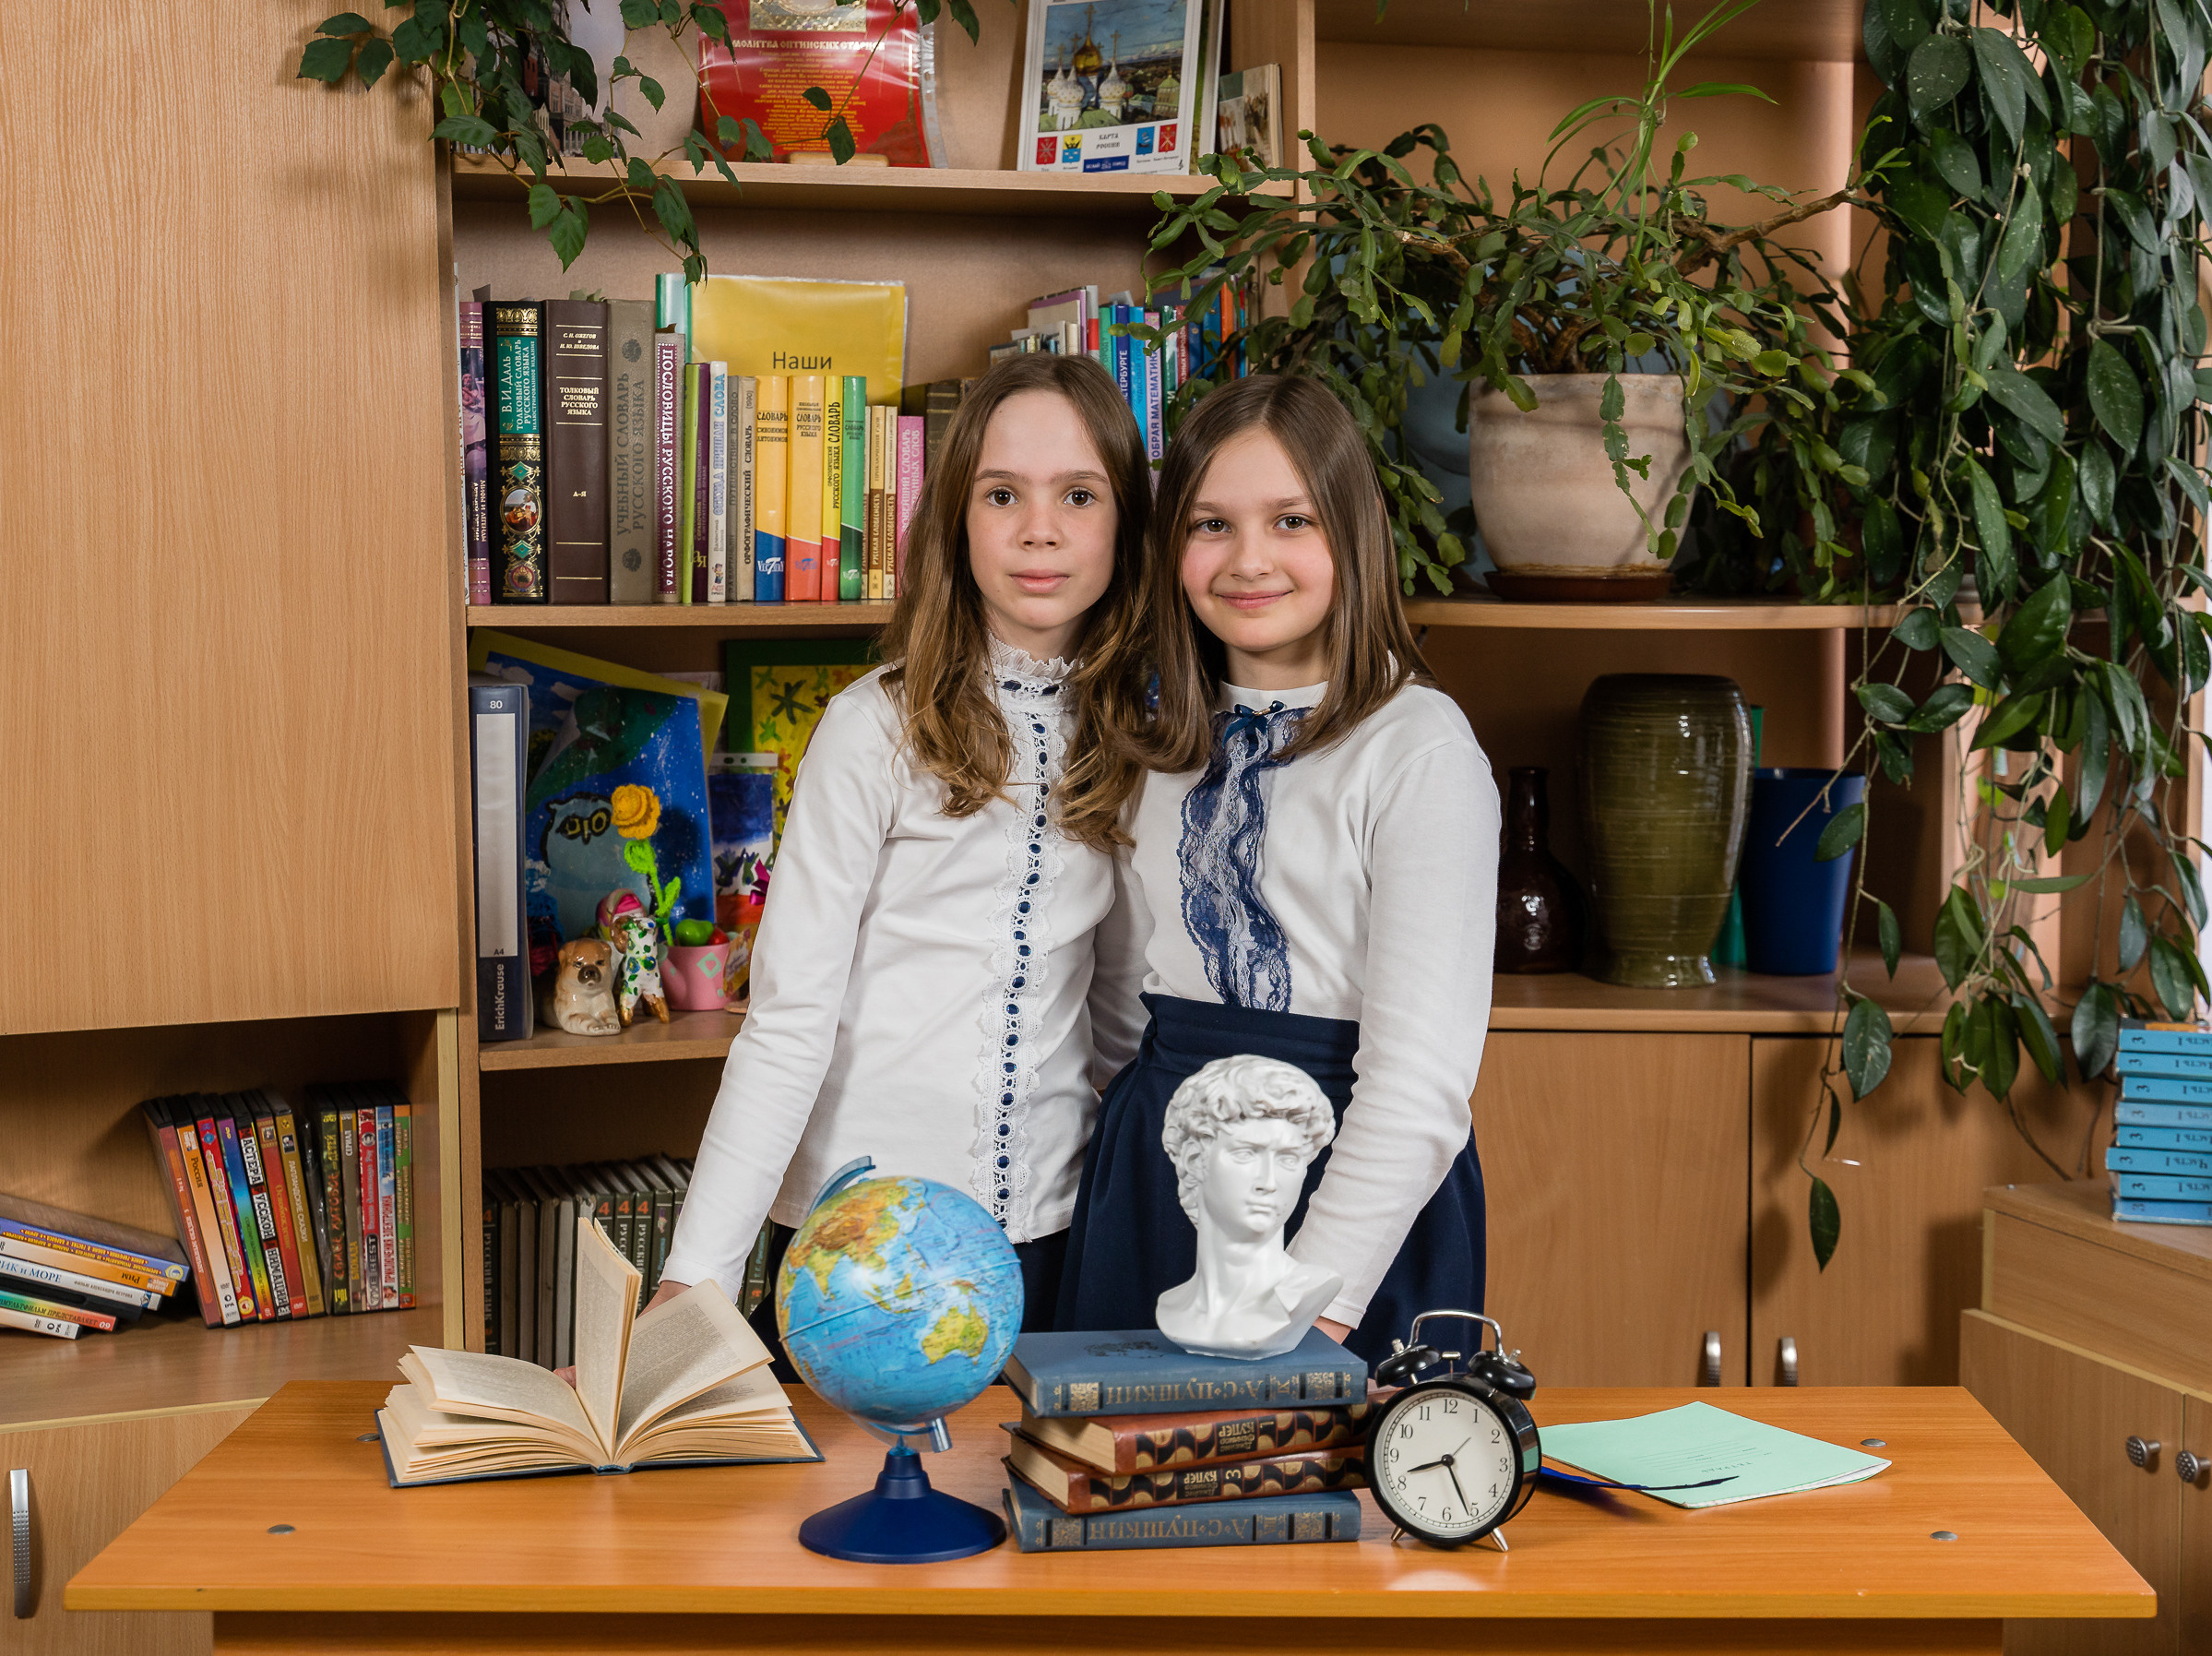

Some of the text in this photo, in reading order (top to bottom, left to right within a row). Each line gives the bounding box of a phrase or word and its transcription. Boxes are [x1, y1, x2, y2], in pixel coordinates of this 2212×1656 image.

[731, 39, 779, 49] МОЛИТВА
[779, 40, 839, 50] ОПТИНСКИХ
[773, 351, 832, 370] Наши
[1135, 340, 1143, 361] ГОРО
[514, 339, 524, 431] ТОЛКОВЫЙ СЛОВАРЬ
[522, 345, 532, 424] РУССКОГО ЯЗЫКА
[559, 387, 600, 395] ТОЛКОВЫЙ
[561, 401, 599, 410] РУССКОГО
[563, 394, 596, 402] СЛОВАРЬ
[660, 349, 674, 445] ПОСЛОВИЦЫ
[756, 411, 789, 422] СЛОВАРЬ
[796, 413, 822, 423] СЛОВАРЬ
[827, 401, 841, 444] СЛОВАРЬ
[713, 373, 725, 516] ОТКУДА ПРИШЛИ СЛОВА
[743, 424, 752, 463] СЛОВАРЬ
[901, 428, 911, 474] СЛОВАРЬ
[910, 429, 921, 458] СЛОВ
[614, 373, 632, 536] УЧЕБНЫЙ СЛОВАРЬ
[632, 379, 647, 531] РУССКОГО ЯЗЫКА
[661, 447, 674, 525] РУССКОГО
[832, 472, 840, 509] РУССКОГО
[743, 471, 752, 565] ОРФОГРАФИЧЕСКИЙ
[871, 493, 881, 566] РУССКАЯ СЛОВЕСНОСТЬ
[886, 495, 895, 572] РУССКАЯ СЛОВЕСНОСТЬ
[490, 700, 503, 709] 80
[494, 963, 505, 1031] ErichKrause
[343, 1130, 353, 1157] СЕРИАЛ
[238, 1126, 265, 1185] МАСТЕРА
[288, 1160, 308, 1243] ЛАПЛАНДСКИЕ СКАЗКИ
[598, 1201, 611, 1216] 4
[618, 1200, 631, 1214] 4
[637, 1200, 649, 1214] 4
[275, 1184, 292, 1249] Освобождение
[382, 1194, 395, 1238] ЭЛЕКТРОНИКА
[349, 1240, 360, 1281] БЛОКАДА
[383, 1239, 396, 1283] ПРИКЛЮЧЕНИЯ
[483, 1232, 493, 1285] РУССКИЙ
[0, 1260, 18, 1273] ИК
[30, 1268, 63, 1283] МОРЕ
[367, 1236, 379, 1305] THE BEST
[1419, 1405, 1431, 1421] 11
[1443, 1399, 1458, 1414] 12
[1473, 1408, 1479, 1423] 1
[1219, 1422, 1255, 1438] КУПЕР
[1400, 1424, 1413, 1439] 10
[1491, 1429, 1501, 1444] 2
[1389, 1448, 1399, 1463] 9
[1499, 1458, 1508, 1472] 3
[1183, 1470, 1218, 1484] КУПЕР
[1225, 1470, 1242, 1480] 3
[1397, 1475, 1407, 1491] 8
[1488, 1483, 1497, 1498] 4
[1418, 1496, 1427, 1511] 7
[1469, 1502, 1480, 1517] 5
[1442, 1507, 1452, 1522] 6
